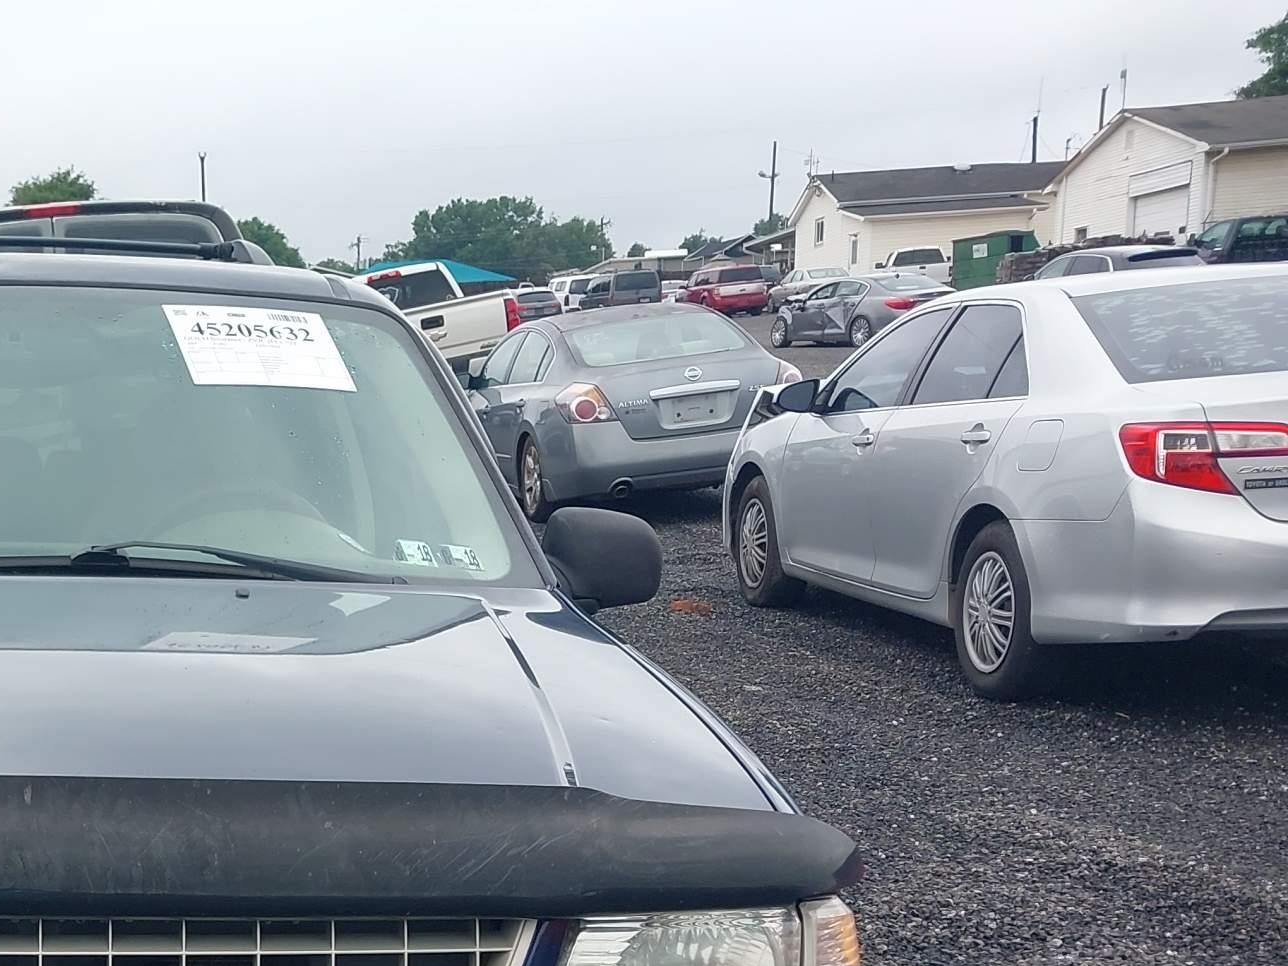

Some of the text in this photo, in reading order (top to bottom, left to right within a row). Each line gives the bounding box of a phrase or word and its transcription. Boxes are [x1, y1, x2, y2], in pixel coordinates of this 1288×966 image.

[191, 321, 315, 342] 45205632
[618, 399, 649, 408] ALTIMA
[1237, 465, 1288, 474] CAMR
